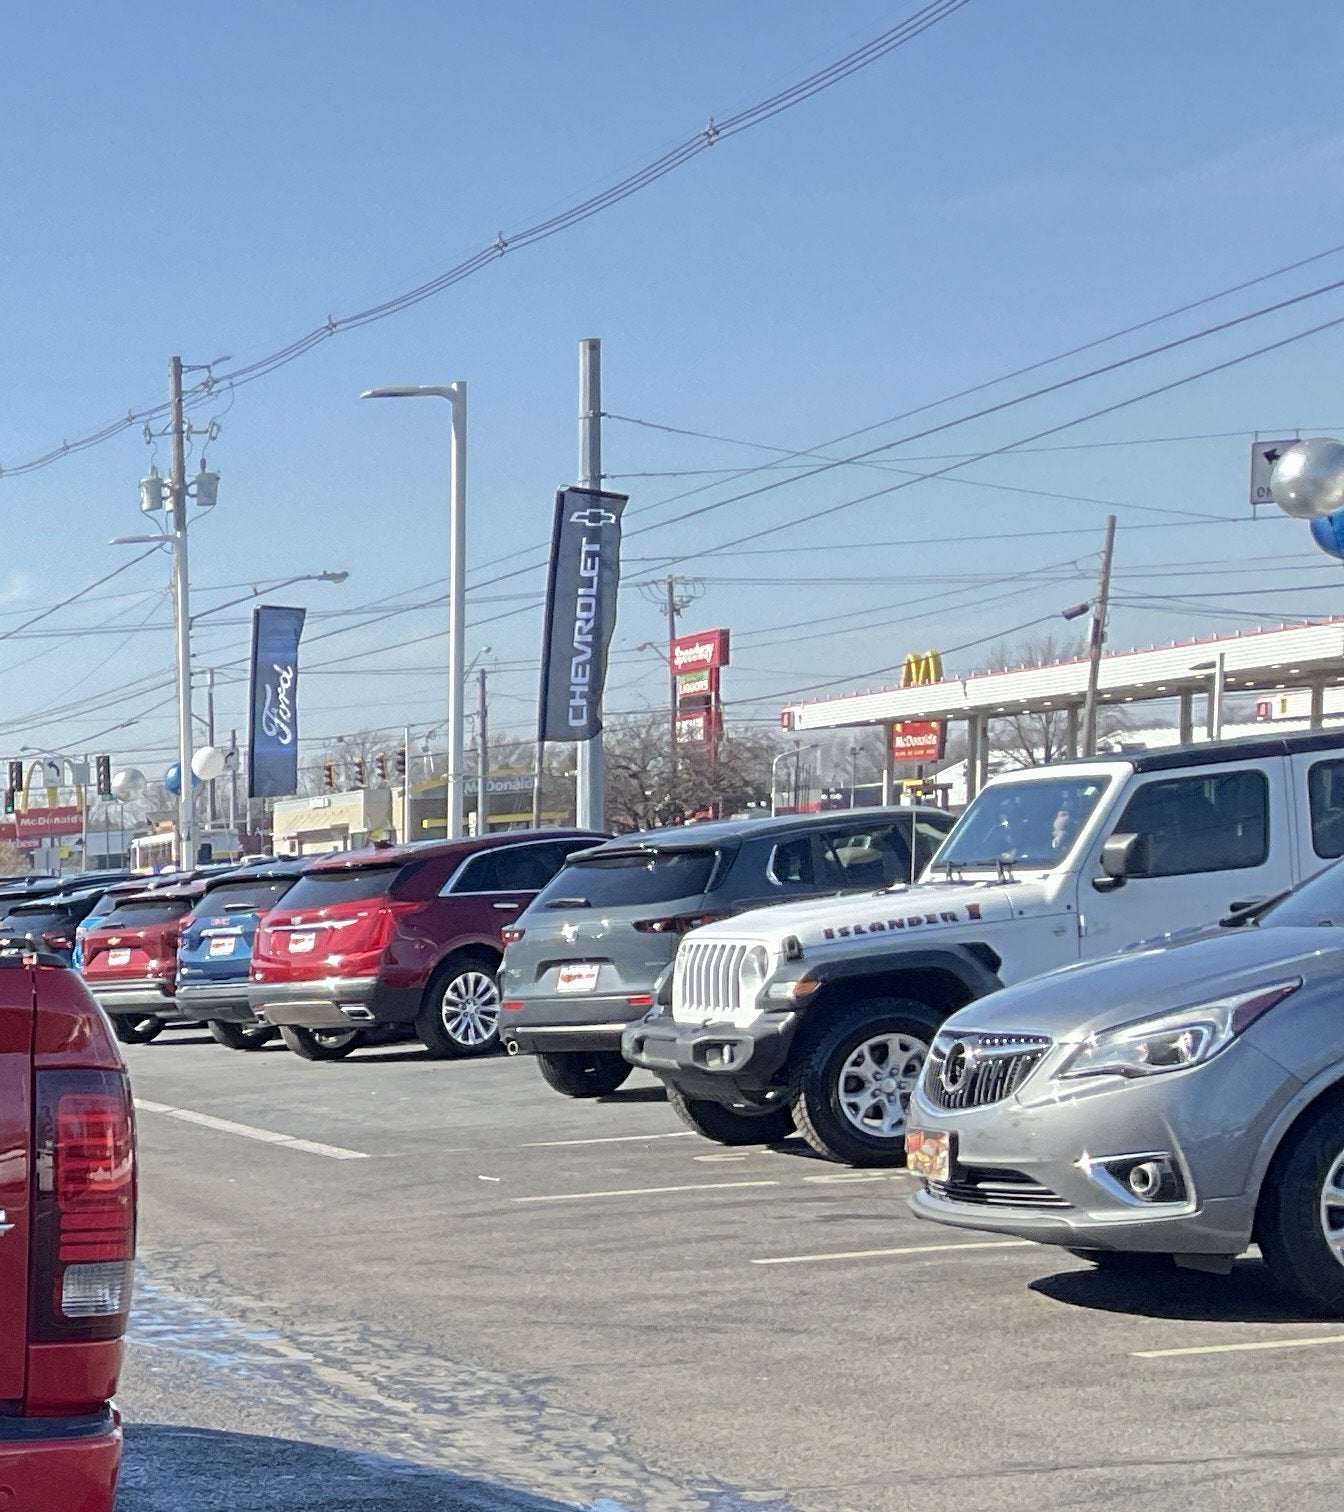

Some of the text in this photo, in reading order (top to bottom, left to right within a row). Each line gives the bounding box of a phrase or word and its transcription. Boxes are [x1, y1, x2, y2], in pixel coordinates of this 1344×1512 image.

[568, 536, 600, 727] CHEVROLET
[262, 663, 293, 745] Ford
[823, 911, 960, 940] ISLANDER
